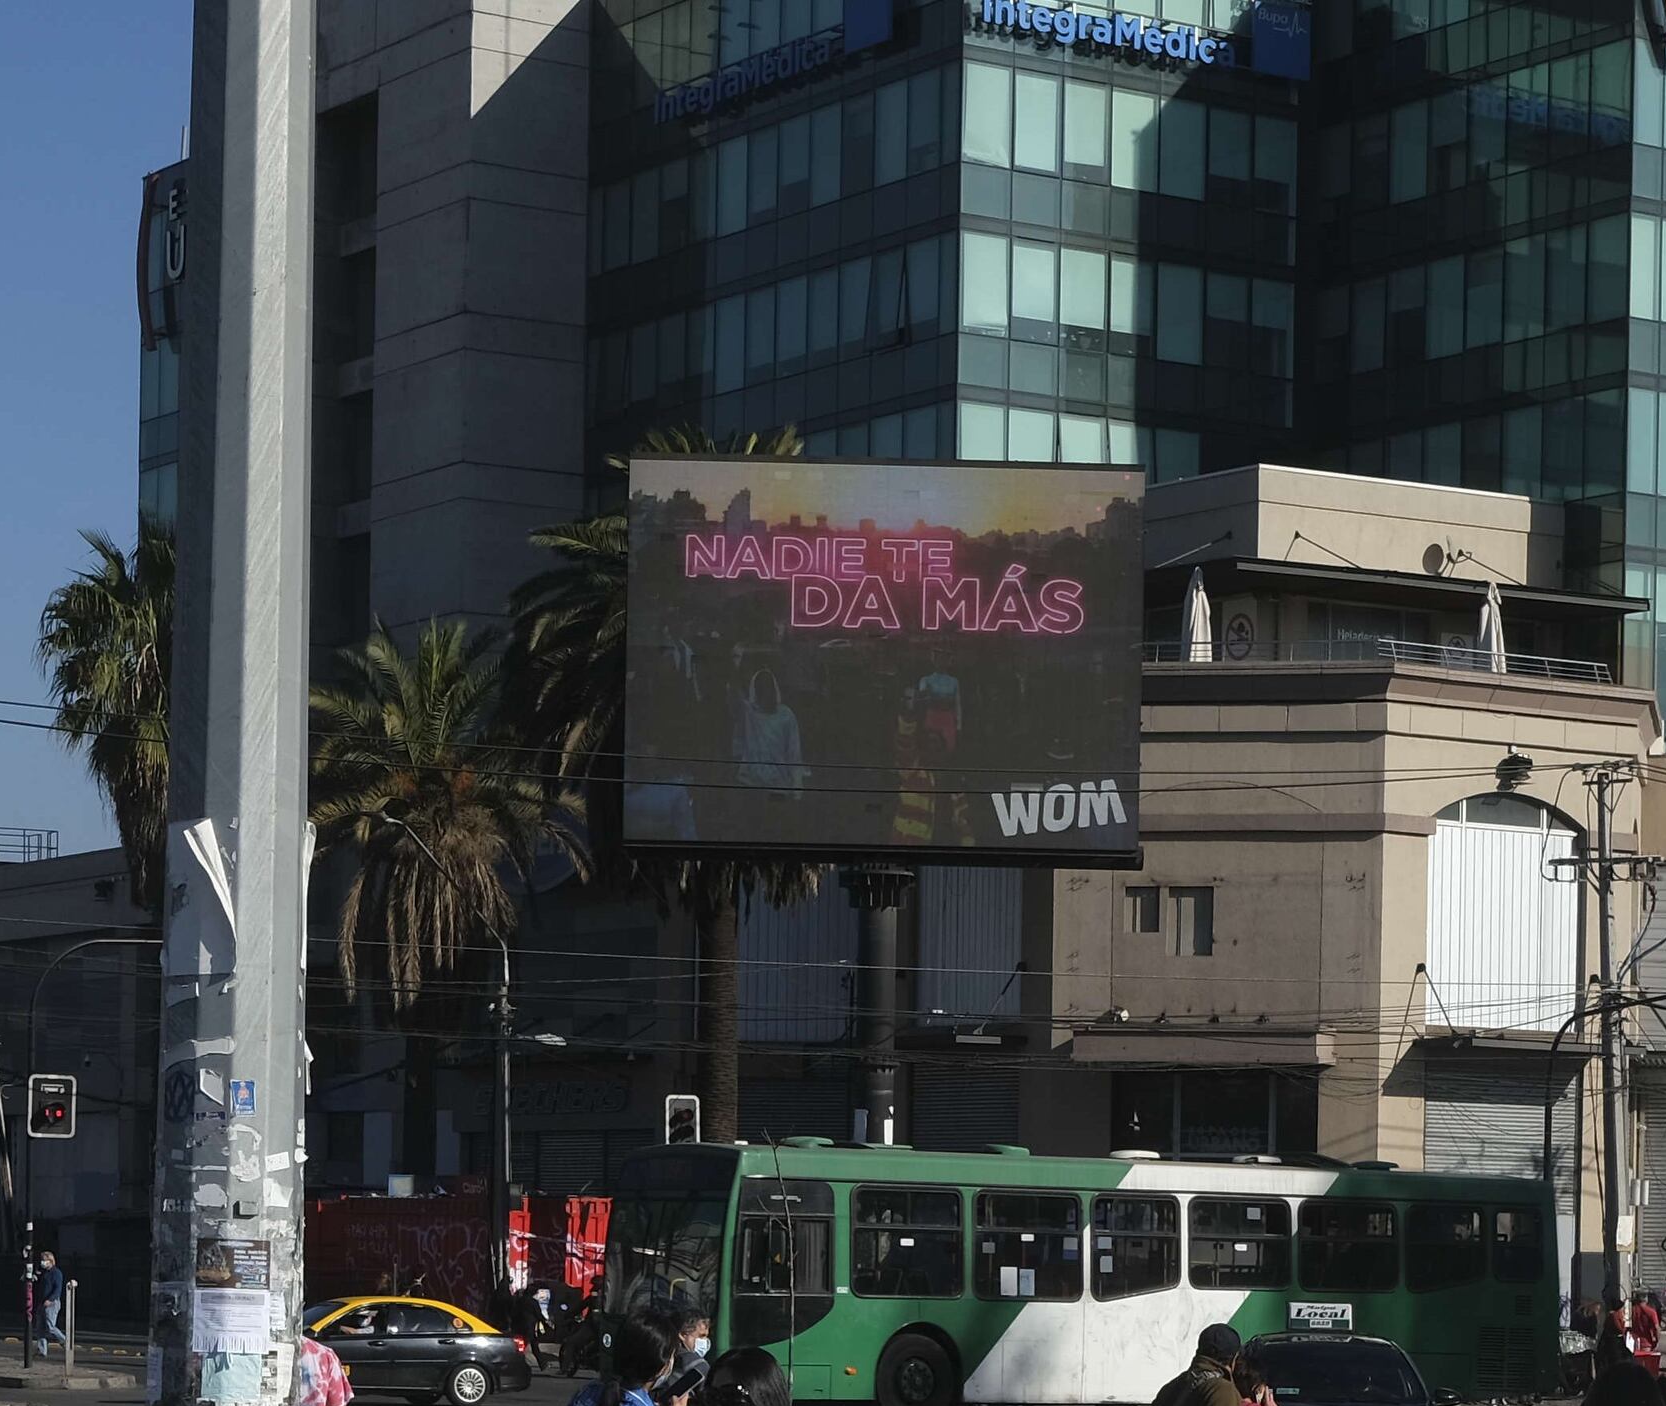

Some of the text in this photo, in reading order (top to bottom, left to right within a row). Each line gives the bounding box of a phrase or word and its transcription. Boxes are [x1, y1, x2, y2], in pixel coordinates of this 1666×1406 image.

[1258, 8, 1289, 24] Bupa
[684, 534, 953, 584] NADIE TE
[790, 563, 1085, 635] DA MÁS
[990, 778, 1128, 837] WOM
[1295, 1308, 1347, 1319] Local
